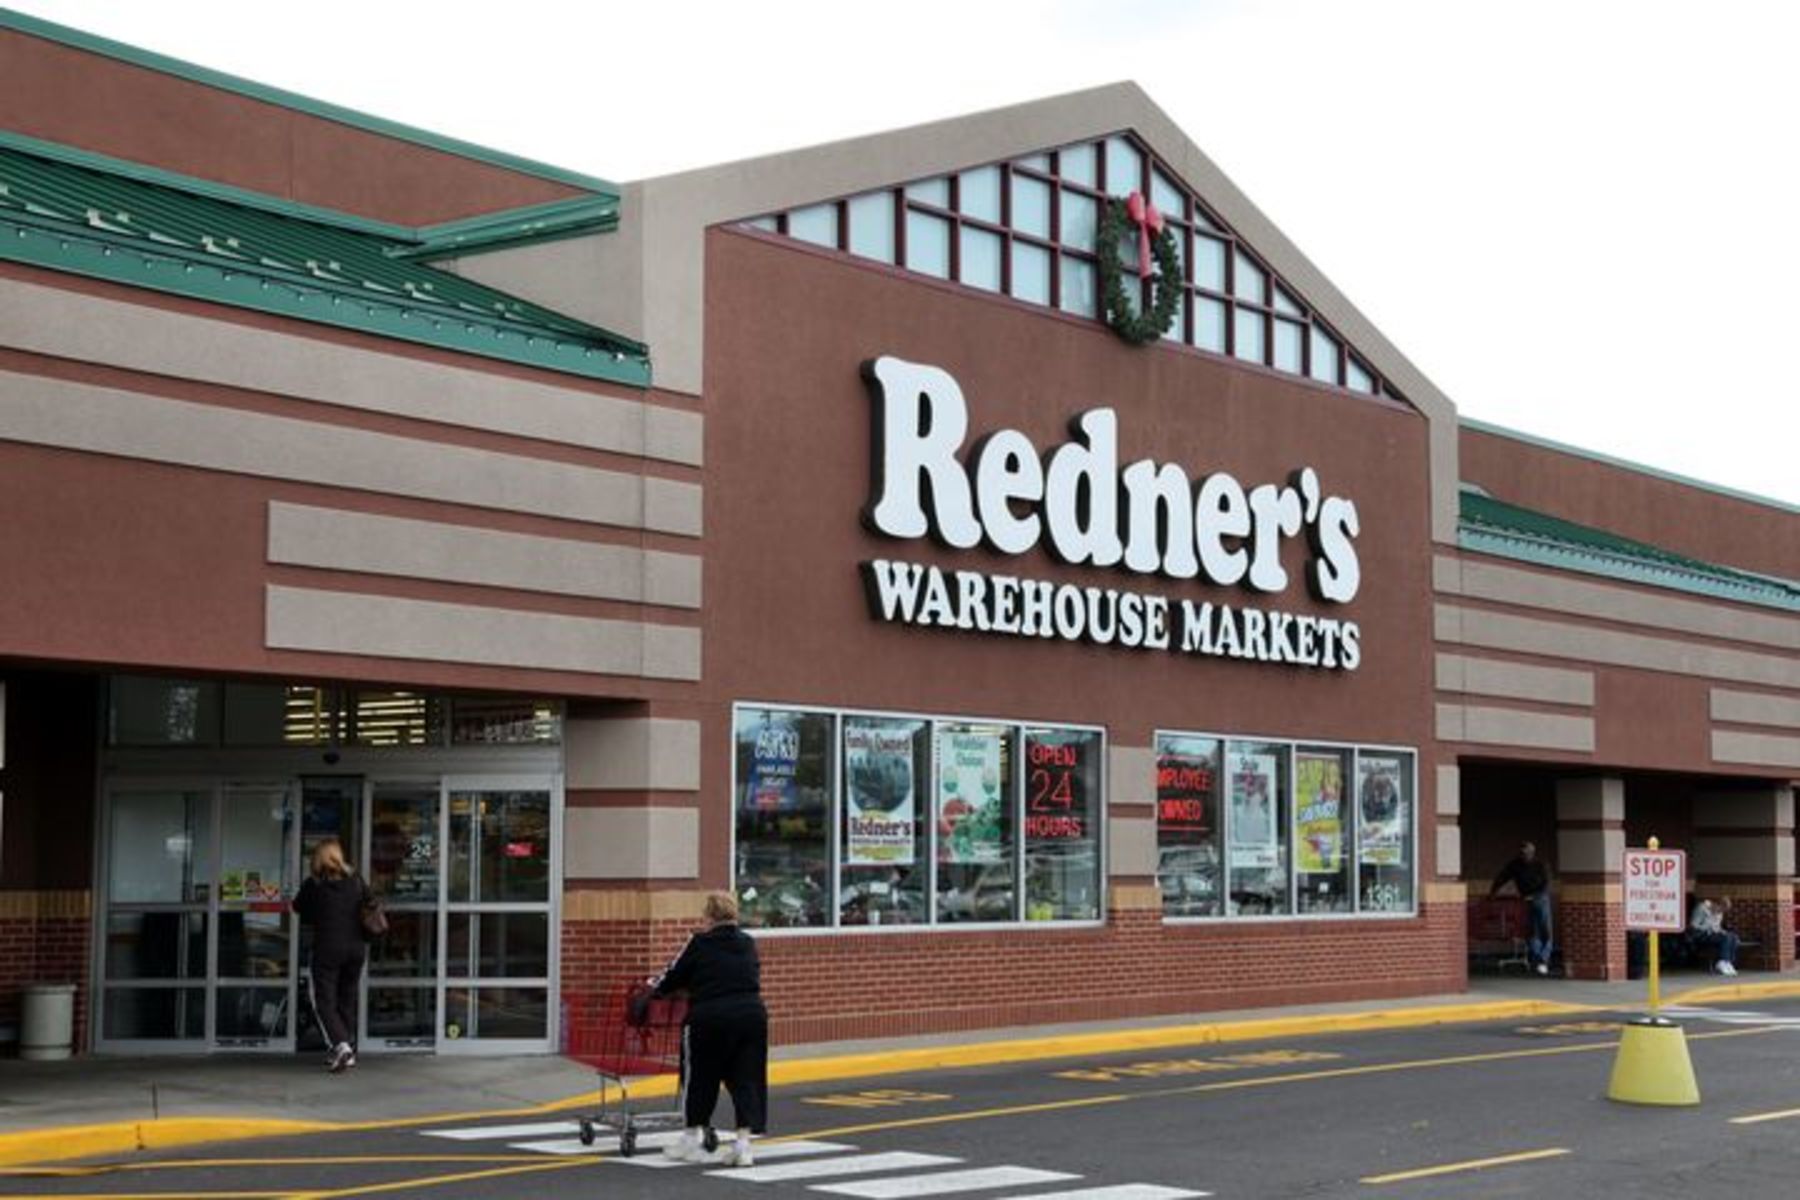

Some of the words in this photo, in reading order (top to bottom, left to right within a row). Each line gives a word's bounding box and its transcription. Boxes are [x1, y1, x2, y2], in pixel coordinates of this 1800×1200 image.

[872, 356, 1361, 604] Redner's
[872, 560, 1169, 650] WAREHOUSE
[1180, 599, 1361, 671] MARKETS
[1030, 744, 1077, 766] OPEN
[1031, 769, 1073, 812] 24
[1025, 815, 1081, 837] HOURS
[1630, 857, 1676, 877] STOP
